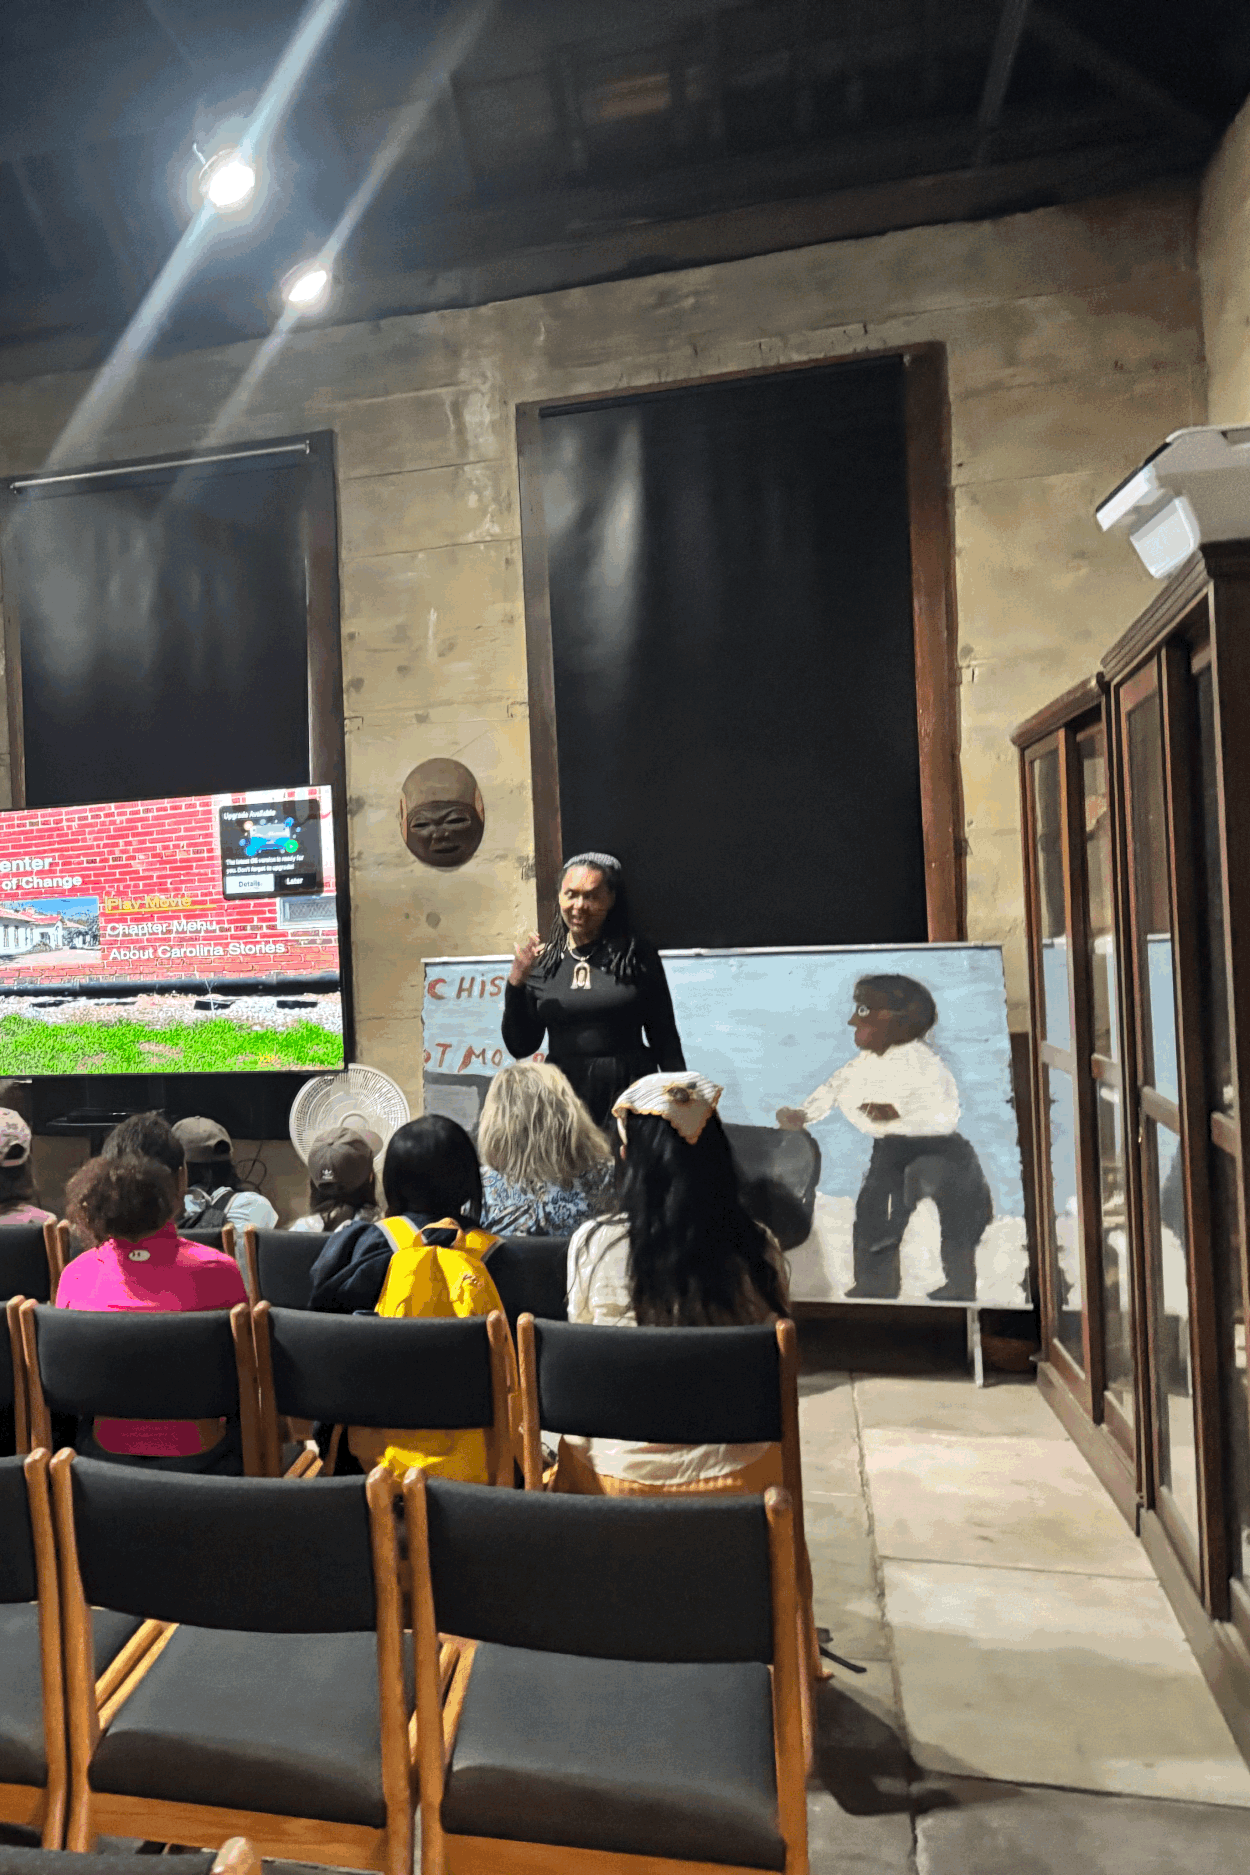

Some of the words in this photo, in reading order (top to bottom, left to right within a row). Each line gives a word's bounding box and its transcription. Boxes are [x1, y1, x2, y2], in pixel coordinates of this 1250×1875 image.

[1, 877, 19, 891] of
[21, 875, 84, 890] Change
[238, 880, 261, 888] Details
[285, 877, 304, 886] Later
[107, 897, 142, 911] Play
[145, 894, 192, 908] Movie
[107, 921, 168, 937] Chapter
[172, 919, 217, 933] Menu
[109, 947, 155, 961] About
[158, 944, 225, 959] Carolina
[228, 941, 286, 956] Stories
